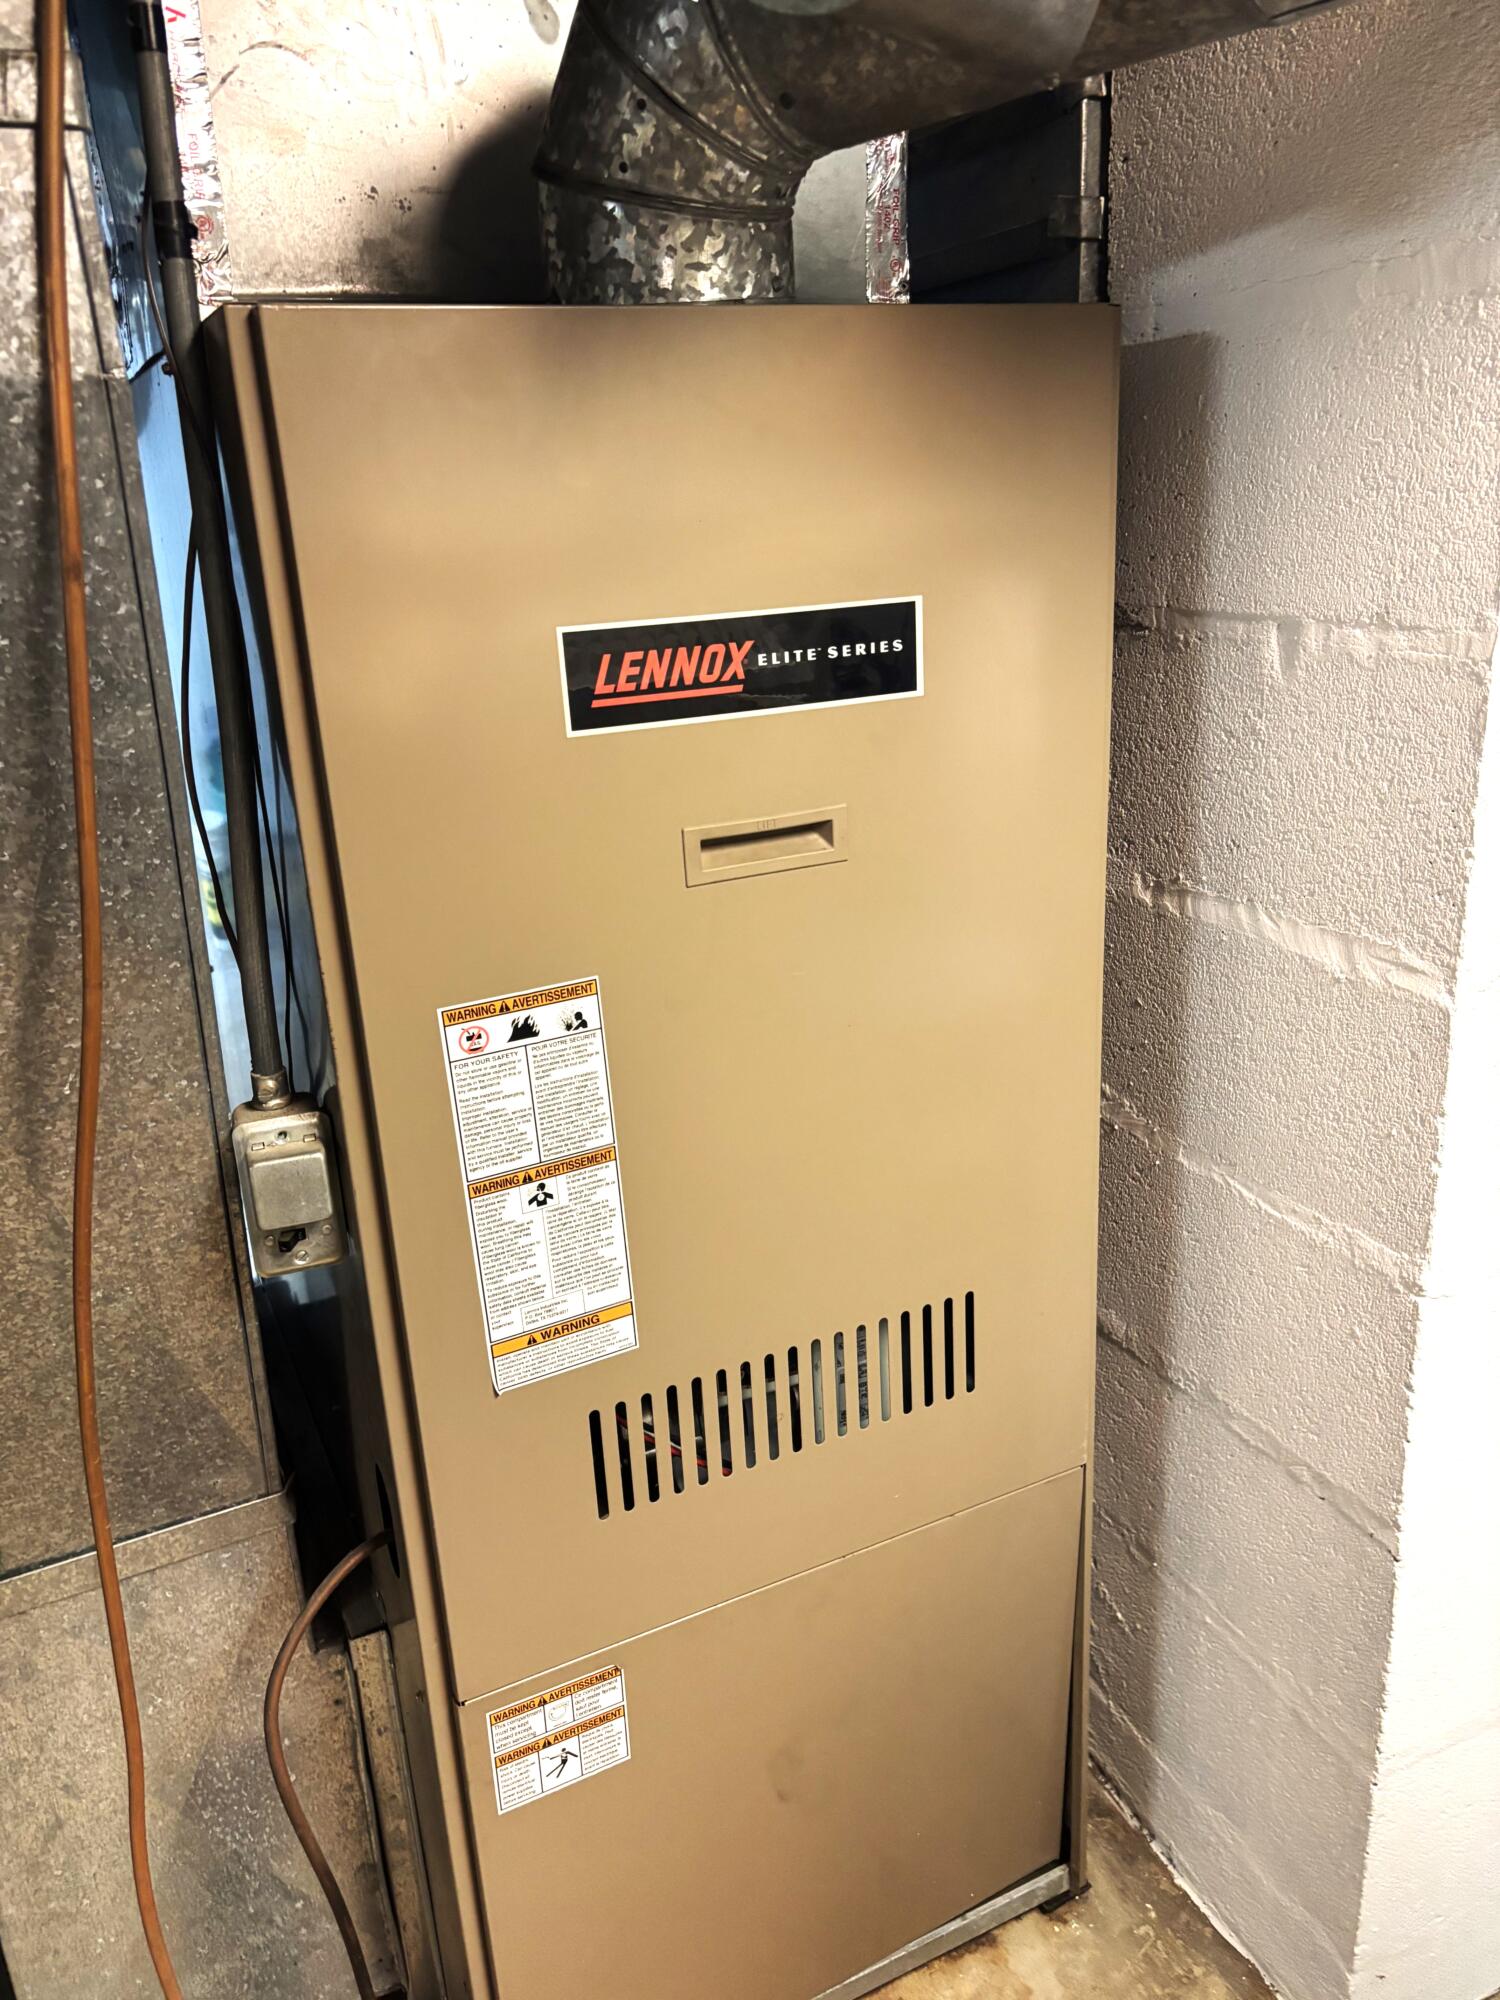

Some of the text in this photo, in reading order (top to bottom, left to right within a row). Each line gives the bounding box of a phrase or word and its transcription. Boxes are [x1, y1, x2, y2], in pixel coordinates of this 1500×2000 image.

[594, 639, 755, 695] LENNOX
[827, 639, 904, 659] SERIES
[446, 982, 594, 1023] WARNING AVERTISSEMENT
[492, 1052, 518, 1061] SAFETY
[472, 1149, 613, 1195] WARNING AVERTISSEMENT
[540, 1314, 600, 1340] WARNING
[493, 1667, 620, 1722] WARNING AVERTISSEMENT
[498, 1709, 622, 1764] WARNING AVERTISSEMENT
